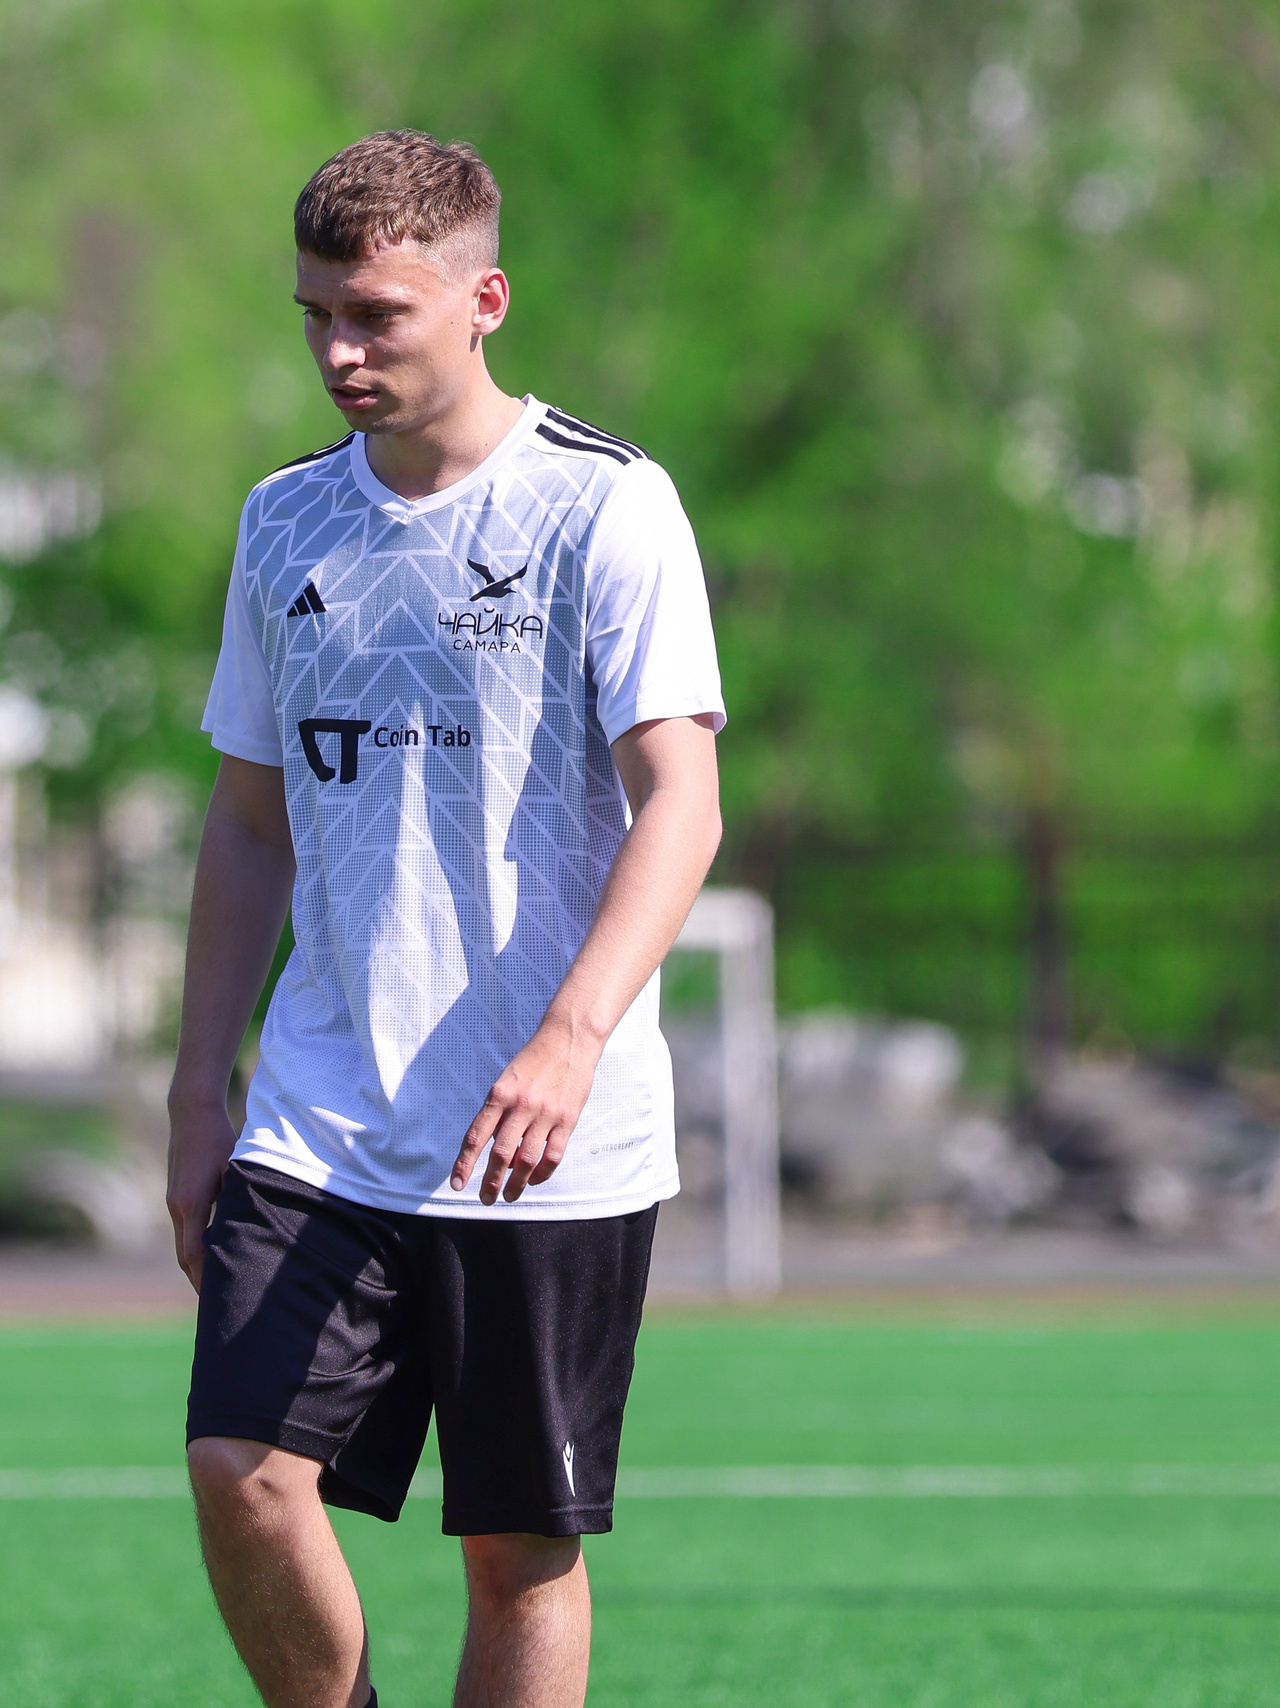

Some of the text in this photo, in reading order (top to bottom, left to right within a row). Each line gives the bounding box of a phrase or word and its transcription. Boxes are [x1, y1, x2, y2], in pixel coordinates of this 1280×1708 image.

[438, 608, 543, 639] ЧАЙКА
[453, 639, 521, 653] САМАРА
[374, 725, 419, 748] Coin
[428, 725, 471, 747] Tab
